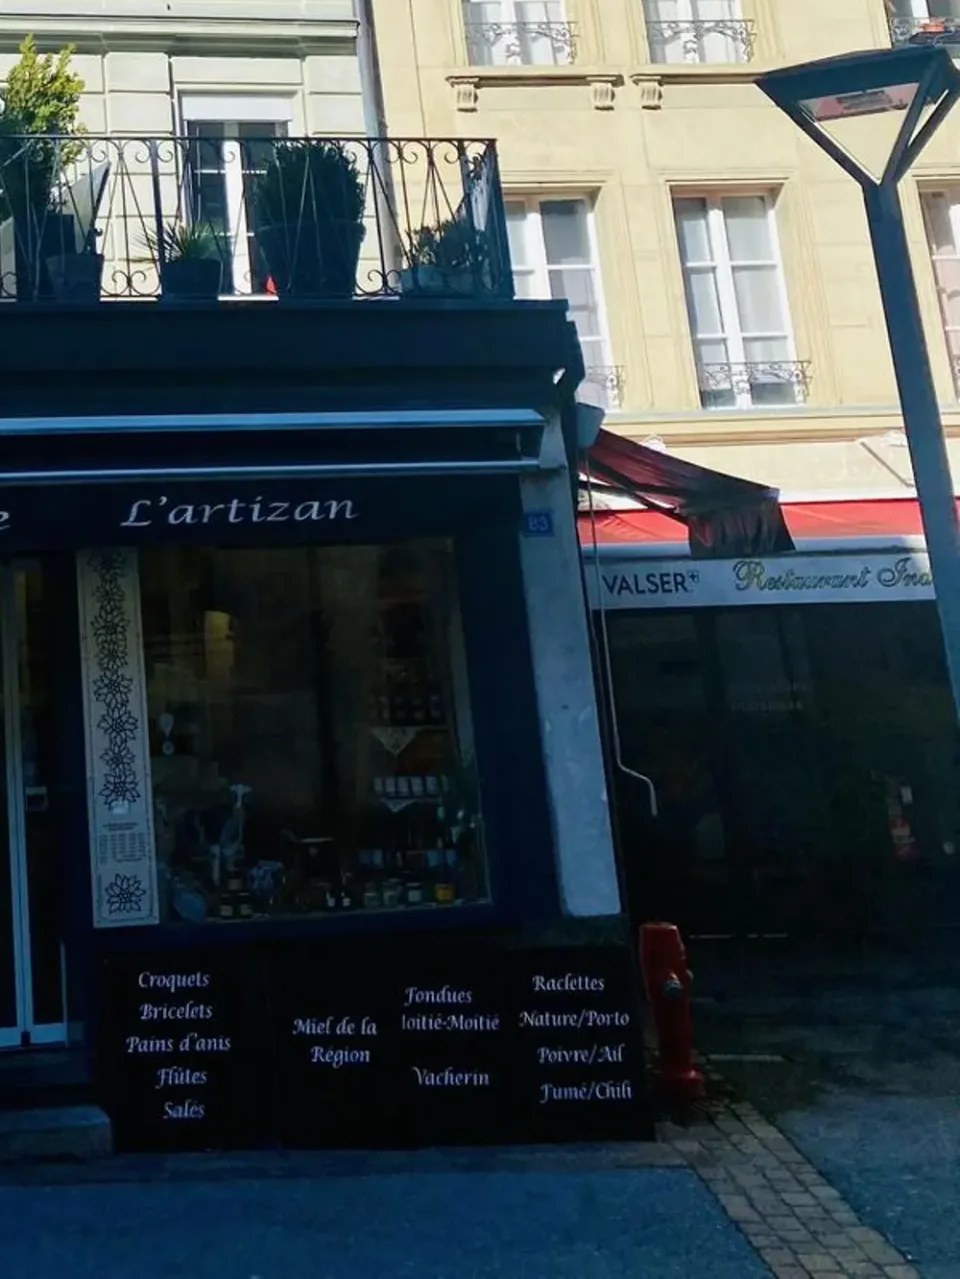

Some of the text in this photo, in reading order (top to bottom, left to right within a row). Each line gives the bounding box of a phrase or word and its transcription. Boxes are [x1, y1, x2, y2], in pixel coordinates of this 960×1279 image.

[120, 496, 360, 527] L'artizan
[602, 572, 688, 595] VALSER
[733, 560, 870, 591] Restaurant
[138, 971, 210, 993] Croquets
[532, 972, 605, 991] Raclettes
[403, 984, 472, 1007] Fondues
[140, 1000, 213, 1020] Bricelets
[519, 1008, 630, 1028] Nature/Porto
[292, 1016, 378, 1035] Miel de la
[402, 1012, 500, 1030] oitié-Moitié
[126, 1035, 174, 1053] Pains
[537, 1043, 625, 1064] Poivre/Ail
[411, 1065, 489, 1086] Vacherin
